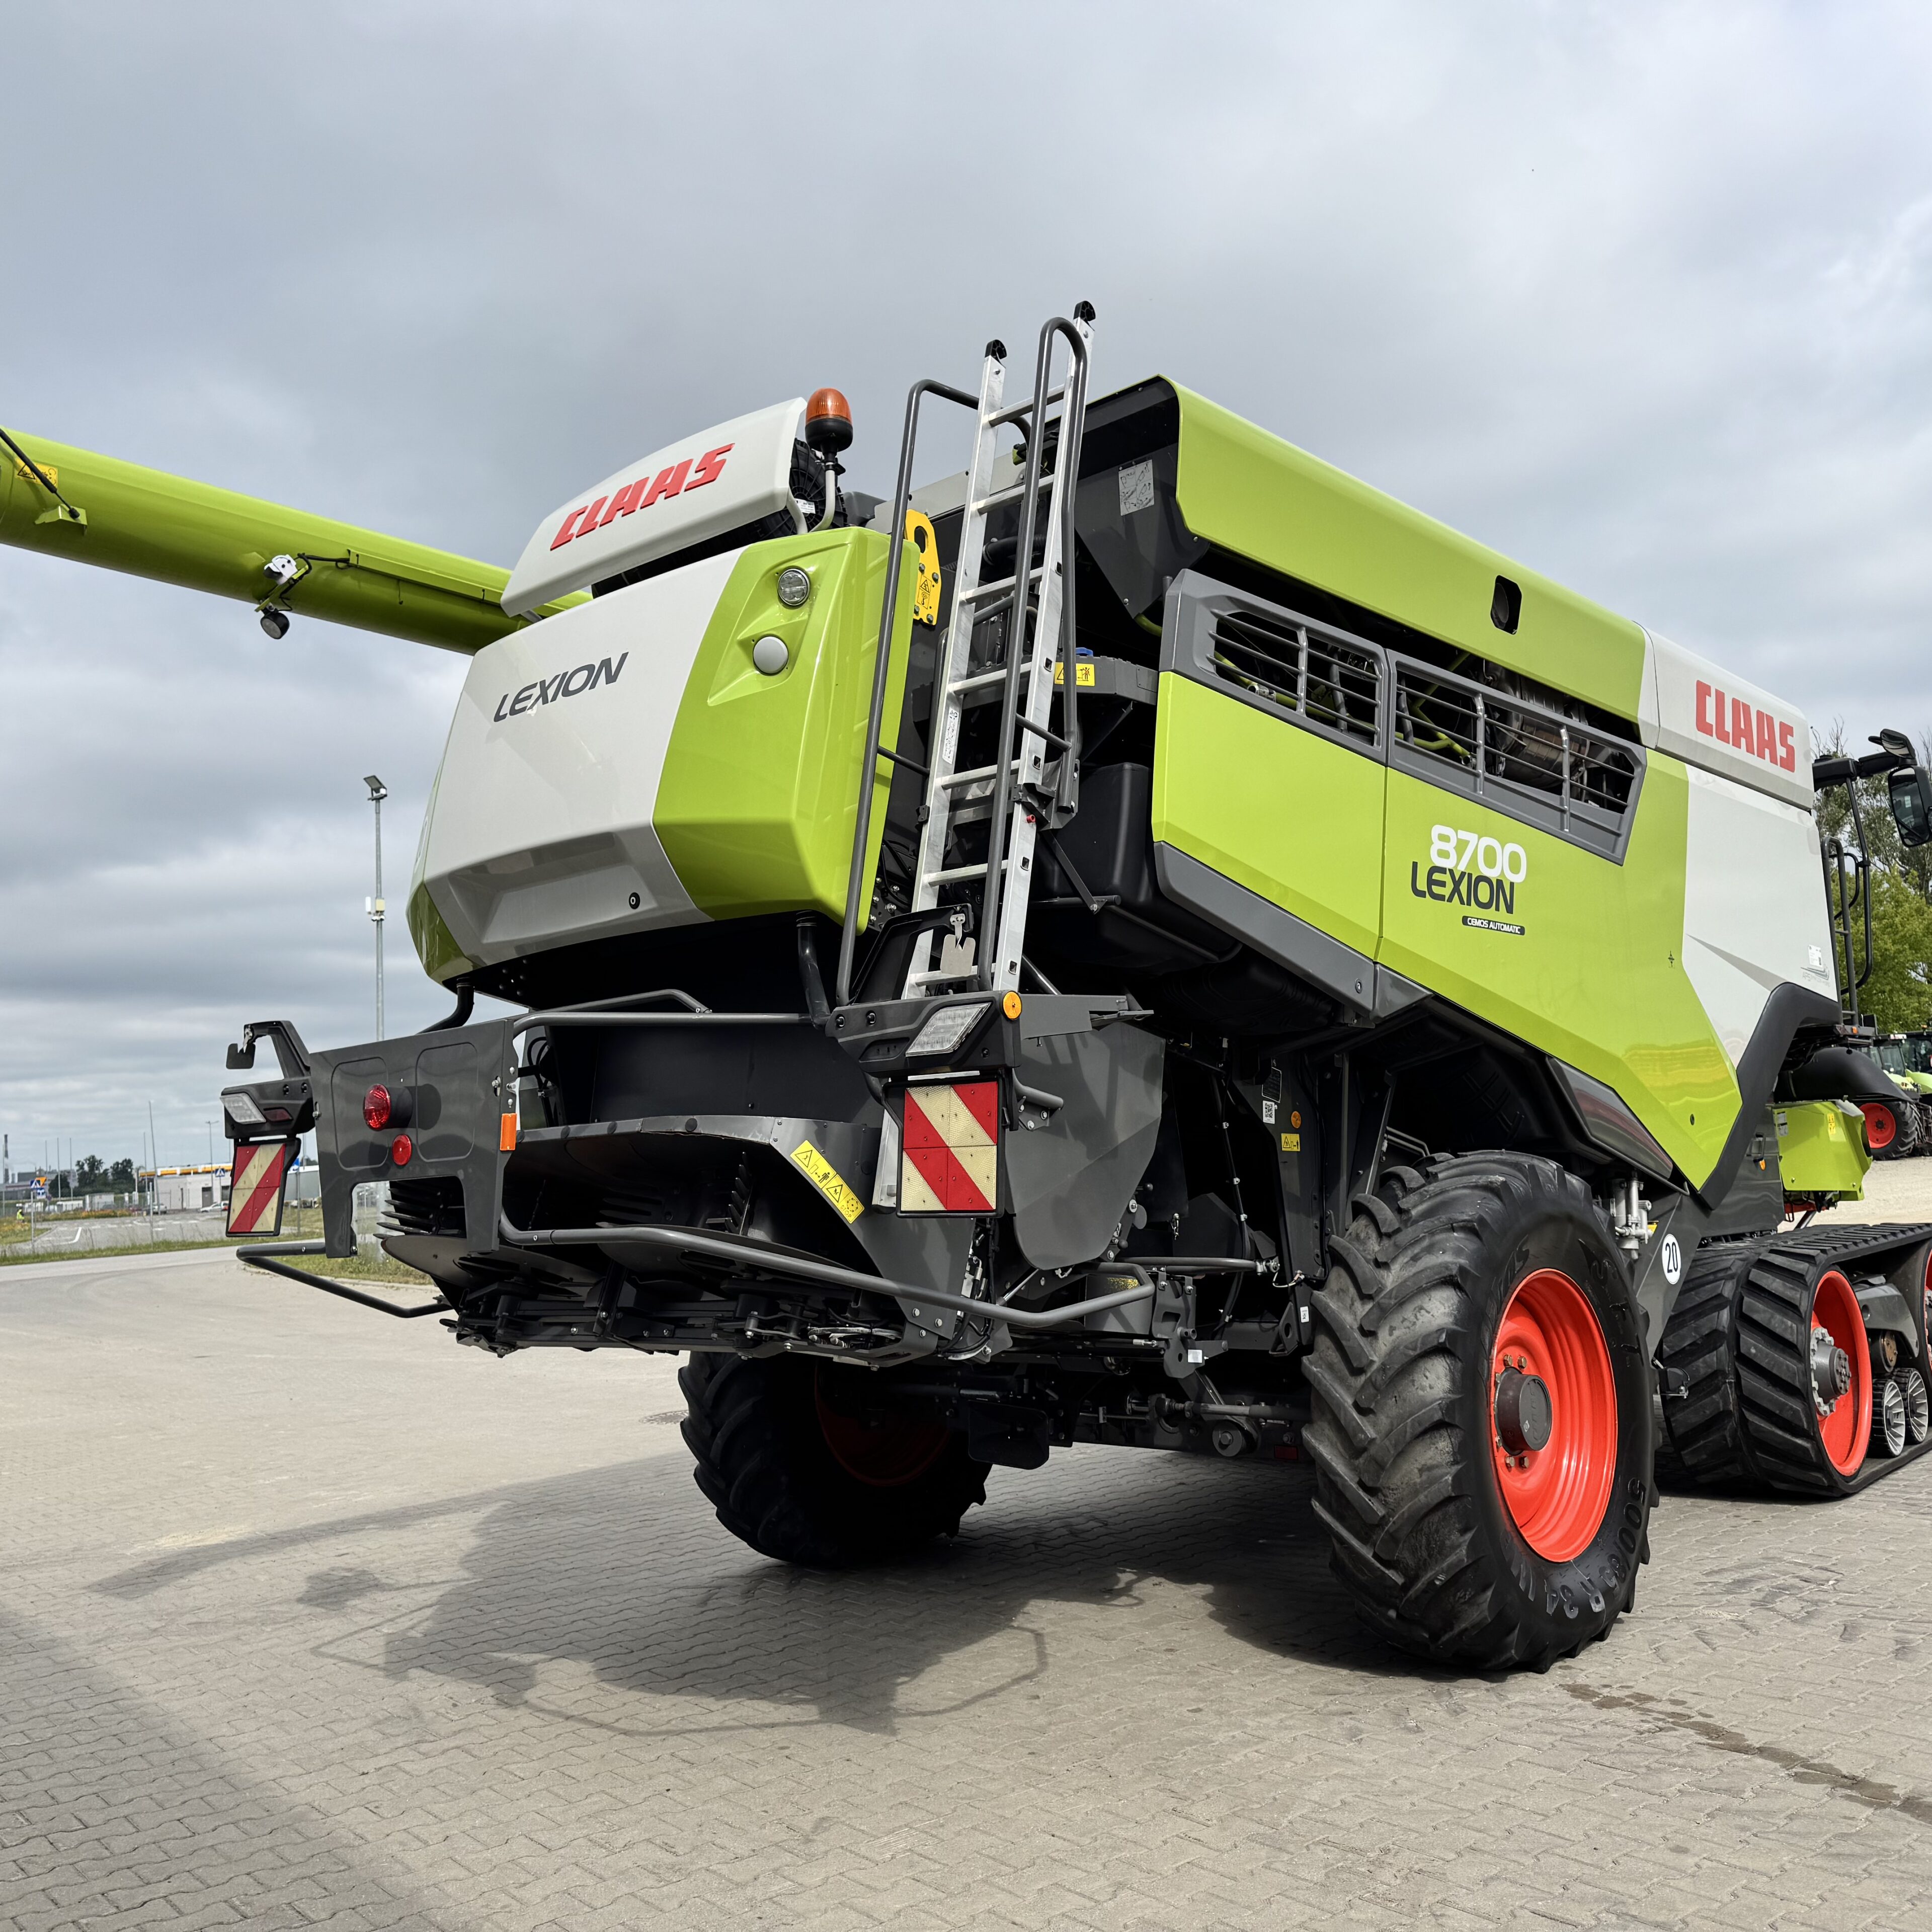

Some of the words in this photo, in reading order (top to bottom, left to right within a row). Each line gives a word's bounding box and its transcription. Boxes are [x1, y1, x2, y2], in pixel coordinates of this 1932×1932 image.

[550, 443, 735, 550] CLAAS
[495, 652, 628, 721] LEXION
[1696, 680, 1795, 772] CLAAS
[1430, 824, 1526, 883] 8700
[1411, 861, 1514, 914] LEXION
[1467, 917, 1489, 928] CEMOS
[1489, 921, 1521, 934] AUTOMATIC
[841, 1205, 852, 1218] STOP
[1665, 1242, 1678, 1273] 20
